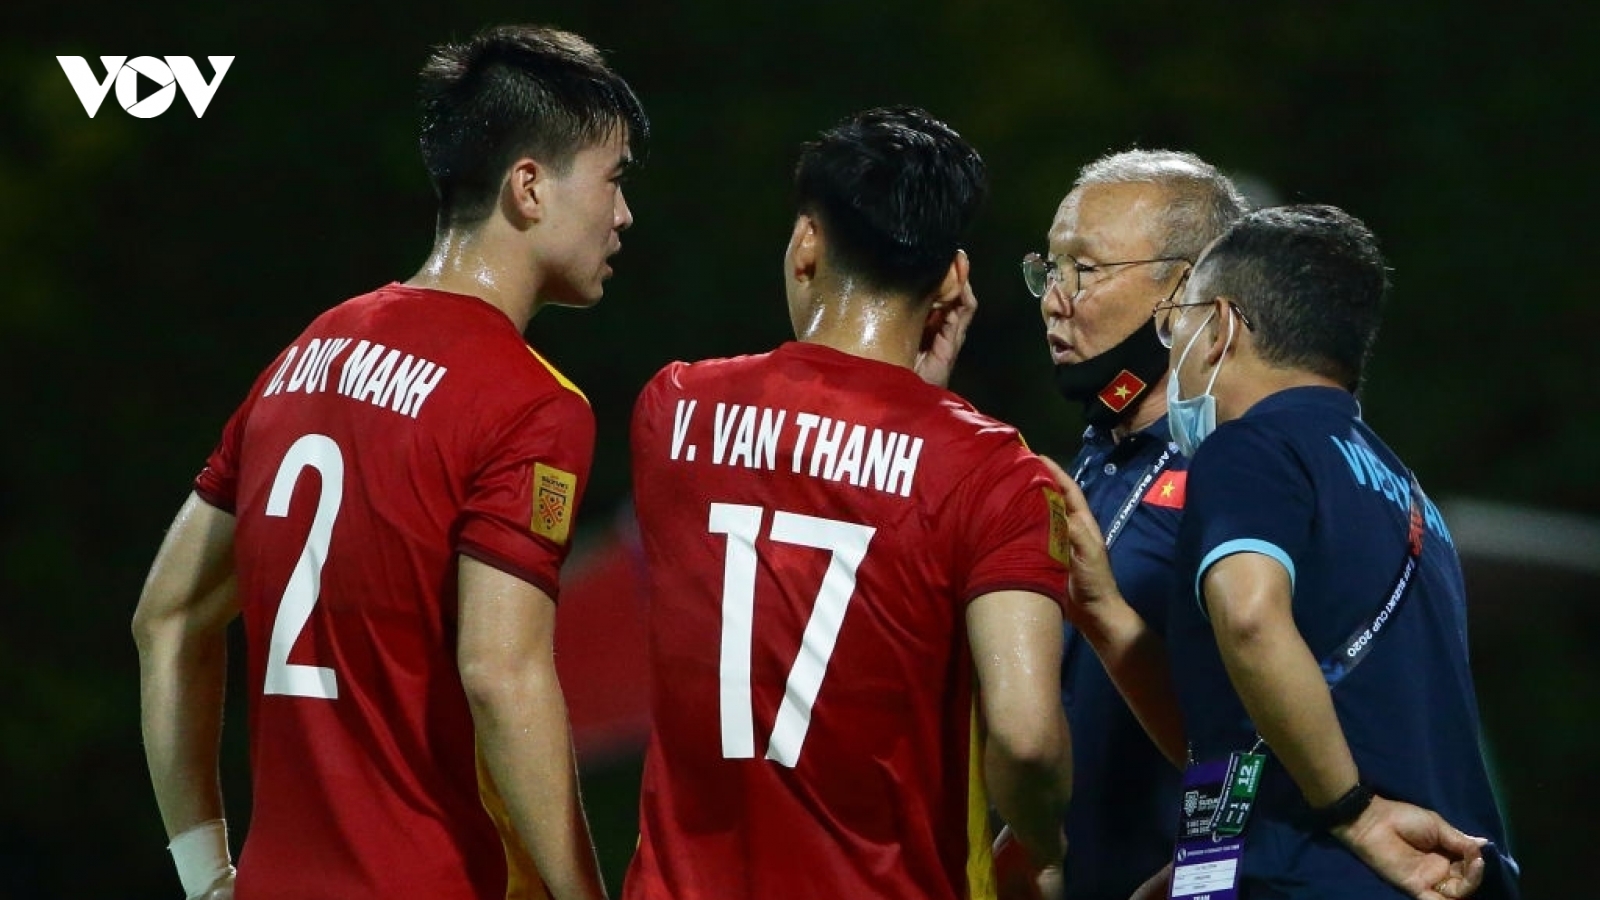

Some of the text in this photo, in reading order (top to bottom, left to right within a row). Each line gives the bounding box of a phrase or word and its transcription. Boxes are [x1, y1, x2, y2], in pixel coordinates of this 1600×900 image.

[263, 338, 447, 419] D. DUY MANH
[670, 399, 923, 497] V. VAN THANH
[263, 433, 344, 699] 2
[708, 502, 877, 768] 17
[1347, 629, 1373, 658] 2020
[1371, 610, 1389, 632] CUP
[1238, 764, 1253, 786] 12
